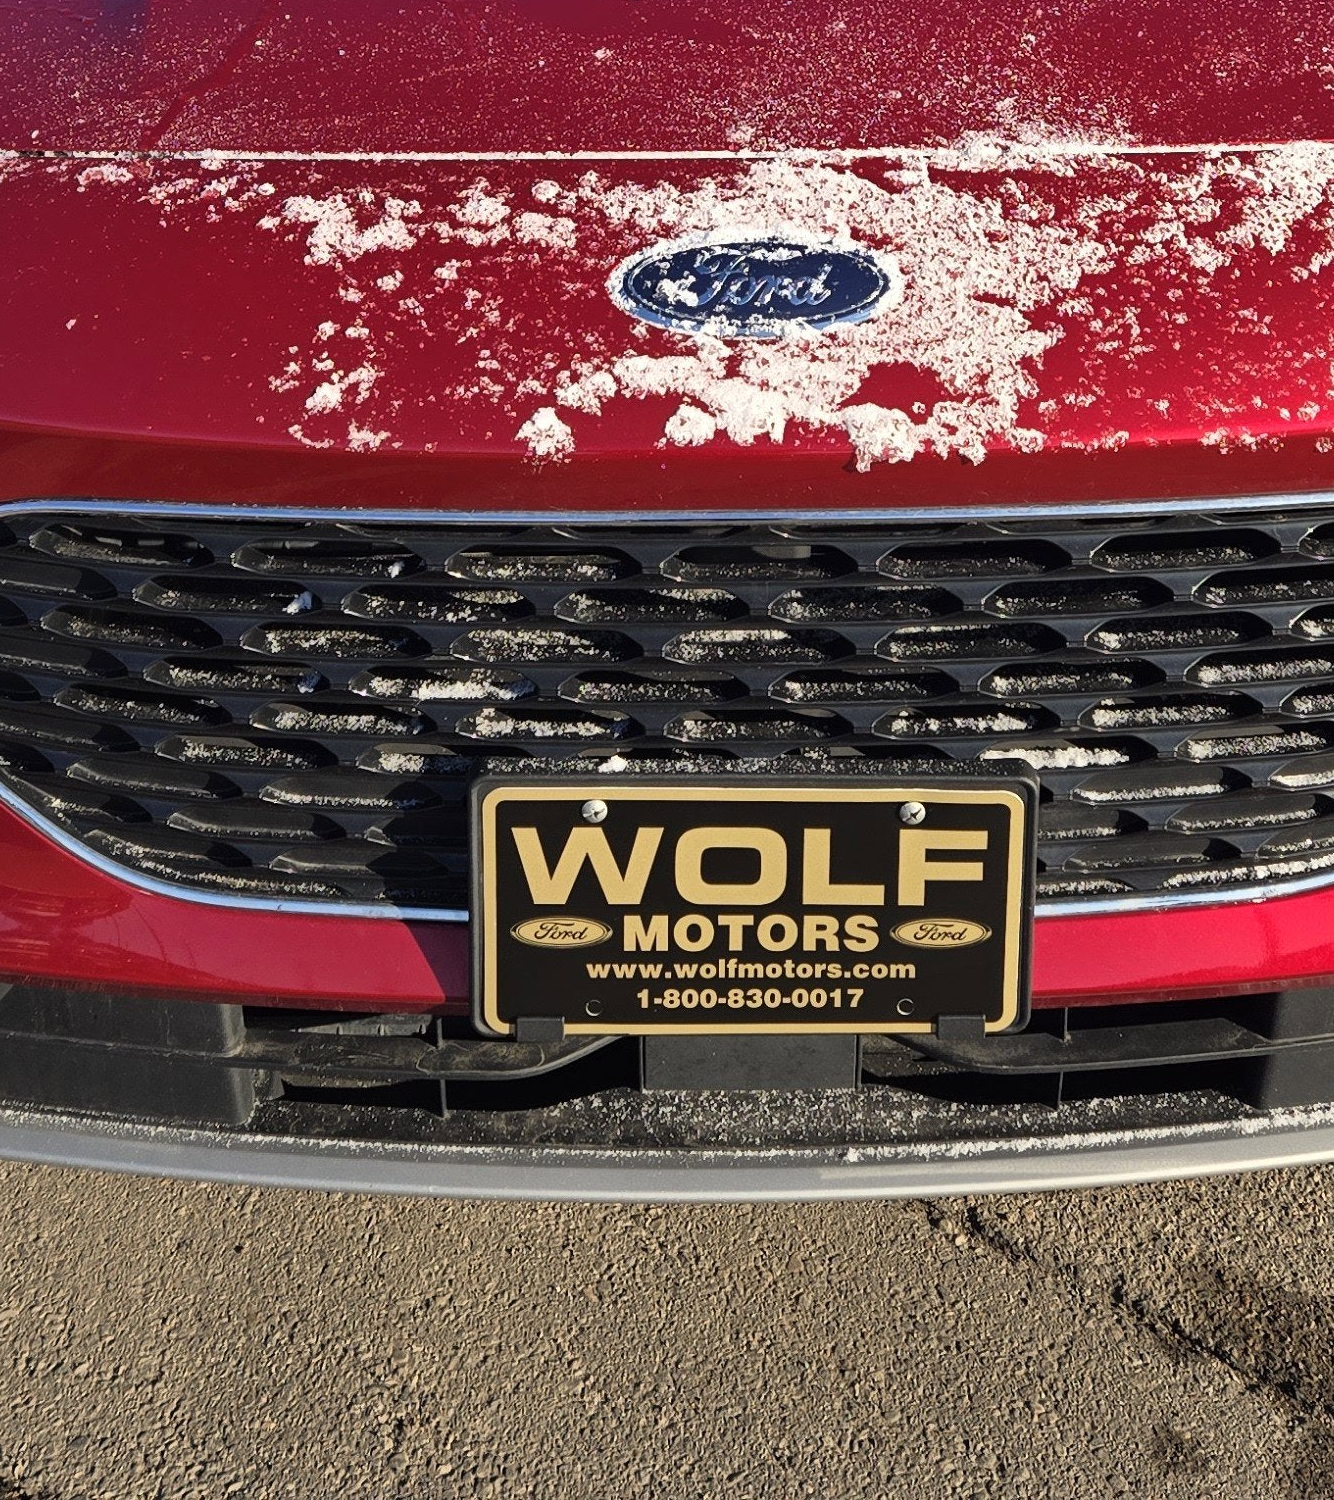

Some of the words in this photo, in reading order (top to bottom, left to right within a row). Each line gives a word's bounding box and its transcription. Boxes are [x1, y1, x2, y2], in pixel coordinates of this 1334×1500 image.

[653, 251, 833, 306] Ford
[510, 825, 989, 907] WOLF
[534, 922, 589, 940] Ford
[622, 913, 880, 953] MOTORS
[913, 922, 969, 941] Ford
[586, 958, 916, 980] www.wolfmotors.com
[636, 988, 865, 1009] 1-800-830-0017
